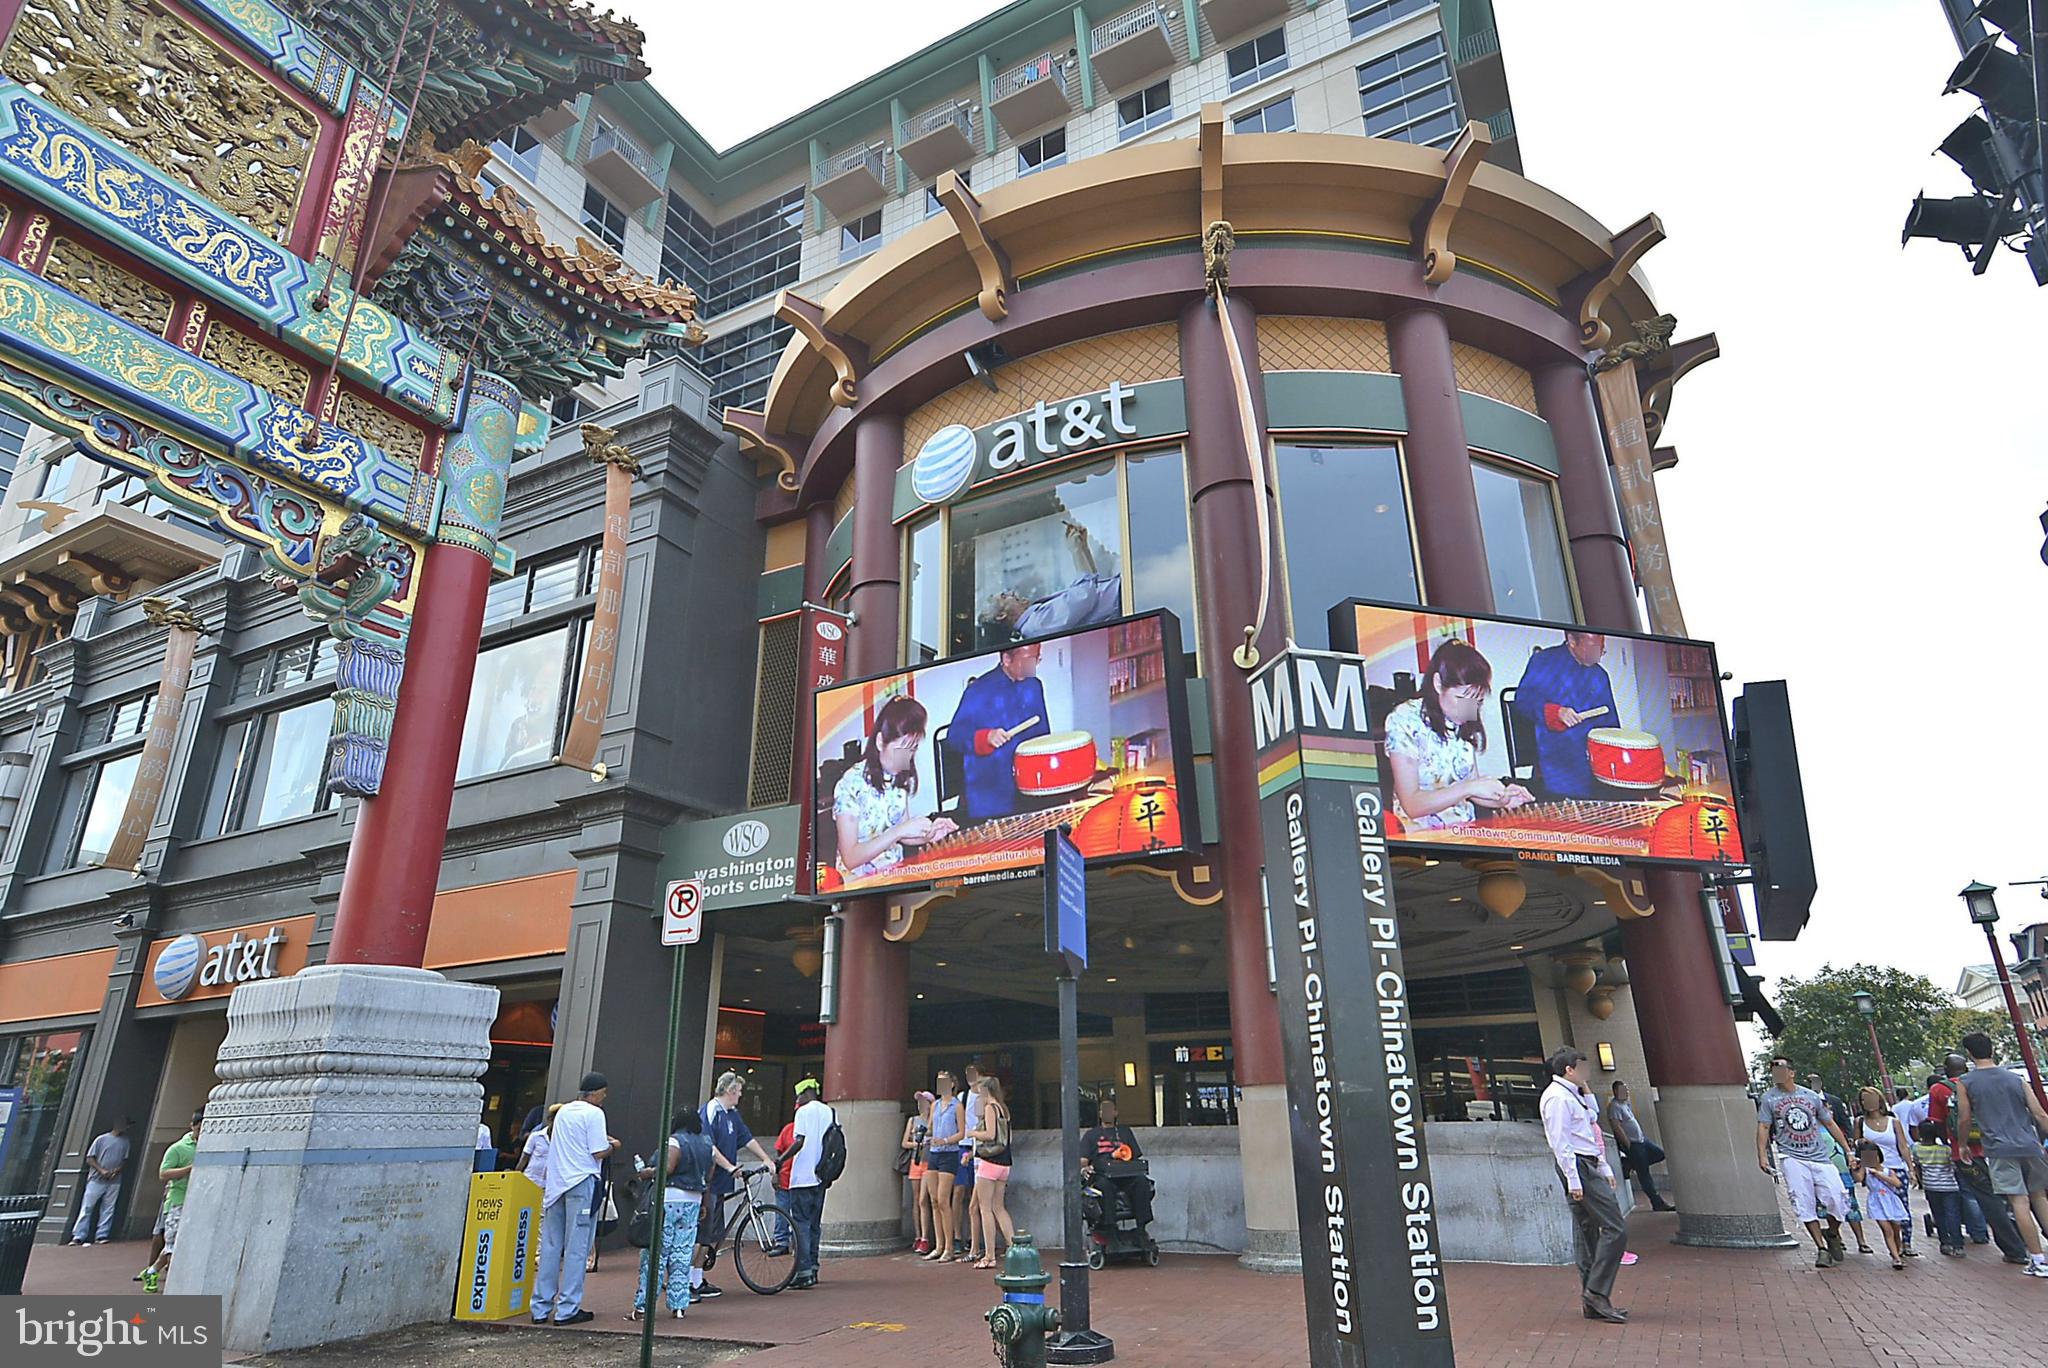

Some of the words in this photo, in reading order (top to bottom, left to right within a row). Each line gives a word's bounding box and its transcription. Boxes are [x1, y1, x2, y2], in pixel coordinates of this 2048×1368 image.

[989, 380, 1137, 470] at&t
[819, 623, 841, 639] WSC
[1251, 660, 1296, 750] M
[1296, 658, 1368, 732] M
[729, 824, 763, 853] WSC
[1451, 825, 1506, 839] Chinatown
[1510, 829, 1568, 844] Community
[1571, 834, 1609, 846] Cultural
[1612, 837, 1645, 849] Center
[694, 856, 795, 881] washington
[881, 864, 930, 878] Chinatown
[933, 855, 986, 871] Community
[990, 848, 1028, 862] Cultural
[1593, 855, 1621, 866] MEDIA
[701, 880, 745, 900] ports
[749, 873, 794, 891] clubs
[200, 926, 281, 986] at&t
[1286, 792, 1310, 909] Gallery
[1324, 1184, 1353, 1334] Station
[1354, 791, 1387, 907] Gallery
[1402, 1182, 1440, 1330] Station
[476, 1198, 503, 1209] news
[476, 1208, 500, 1221] brief
[513, 1209, 529, 1280] express
[472, 1232, 490, 1310] express
